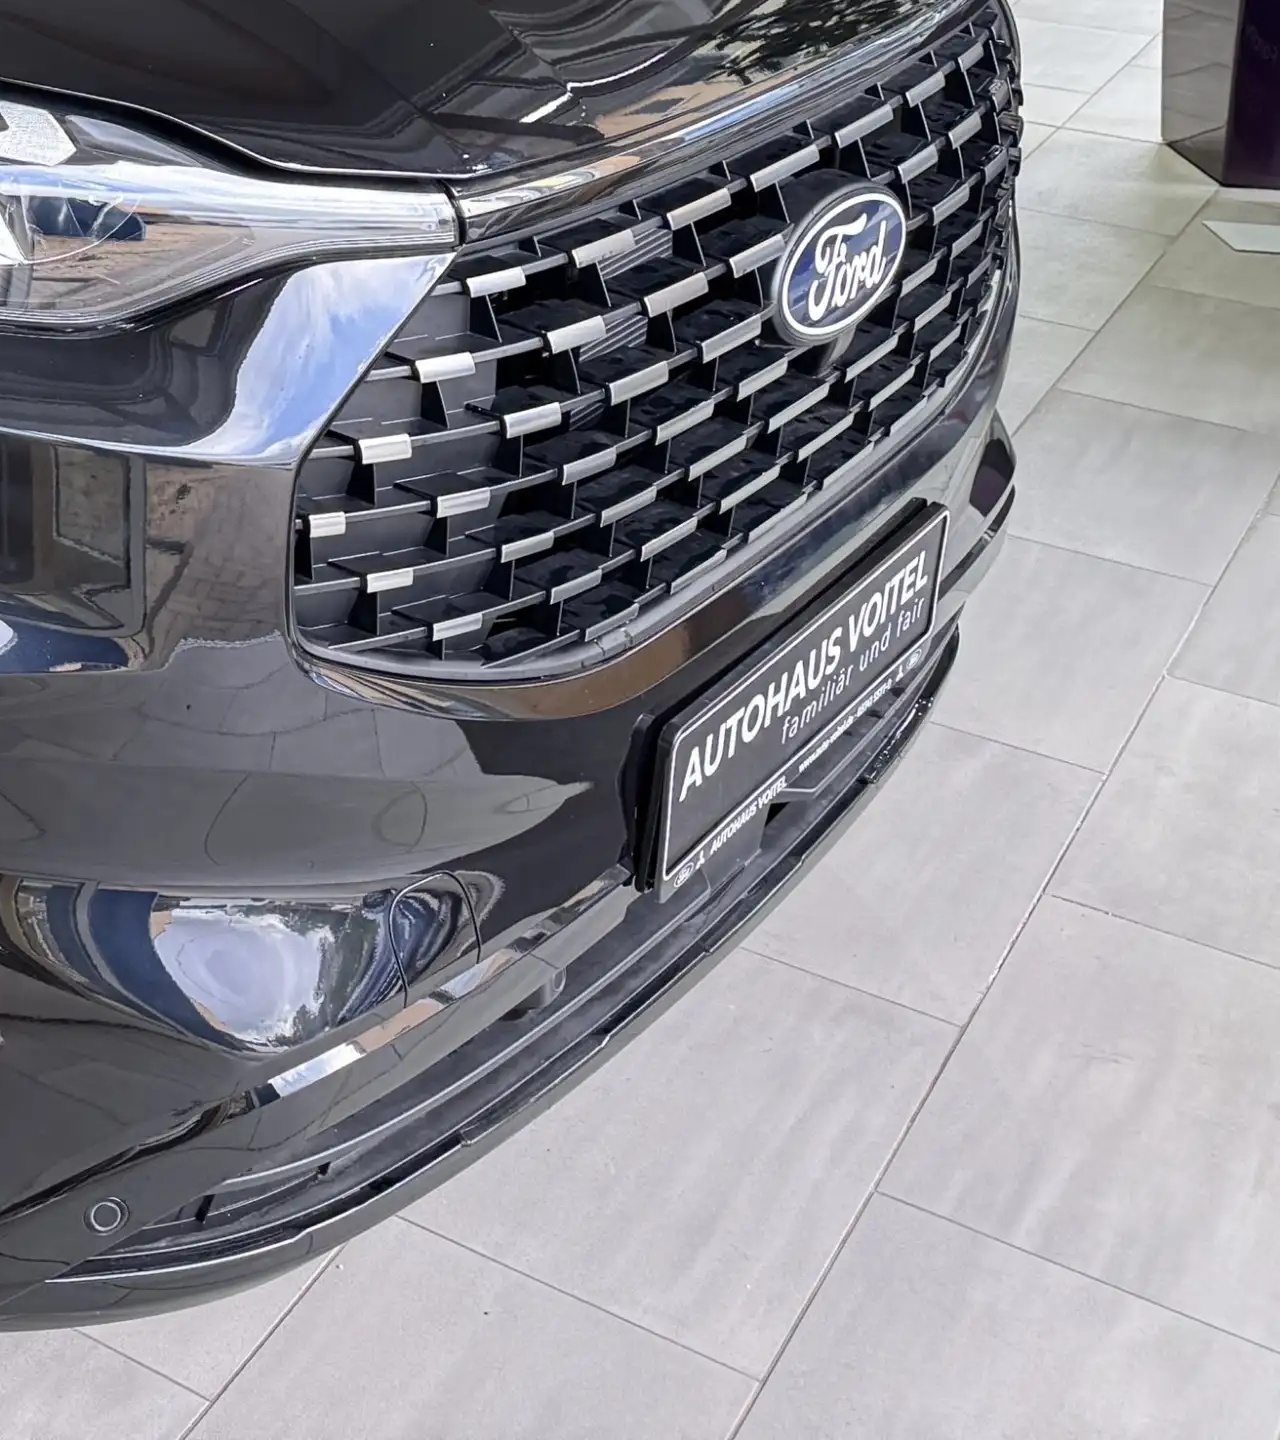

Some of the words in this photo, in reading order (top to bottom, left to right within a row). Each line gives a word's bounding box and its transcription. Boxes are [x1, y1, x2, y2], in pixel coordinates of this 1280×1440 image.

[807, 211, 889, 322] Ford
[679, 629, 842, 802] AUTOHAUS
[848, 550, 928, 653] VOITEL
[781, 664, 853, 745] familiär
[859, 623, 891, 672] und
[896, 595, 926, 638] fair
[709, 800, 758, 855] AUTOHAUS
[758, 775, 788, 809] VOITEL
